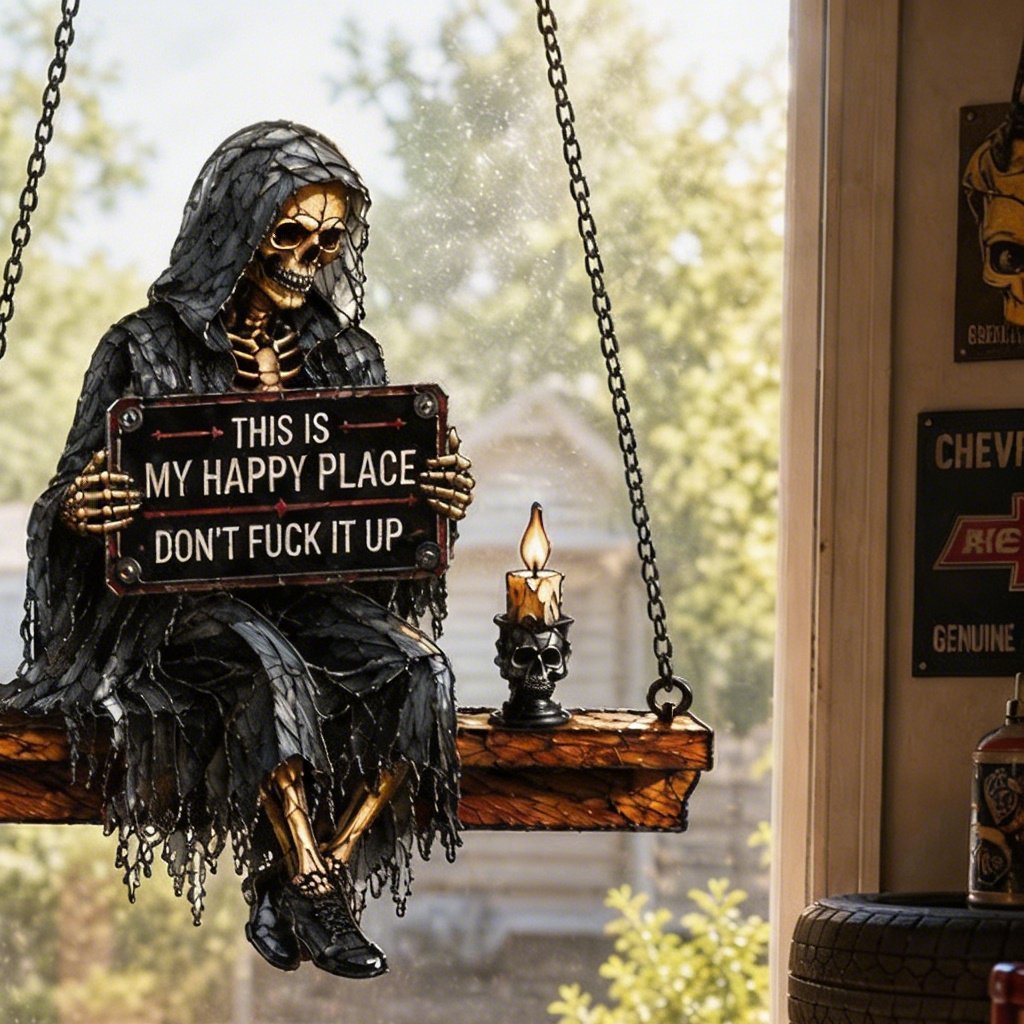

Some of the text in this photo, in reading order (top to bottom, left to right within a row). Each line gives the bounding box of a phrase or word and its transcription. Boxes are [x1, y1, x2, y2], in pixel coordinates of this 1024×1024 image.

[231, 412, 330, 449] THIS IS
[145, 449, 417, 499] MY HAPPY PLACE
[155, 517, 403, 564] DON'T FUCK IT UP
[932, 623, 1016, 653] GENUINE
